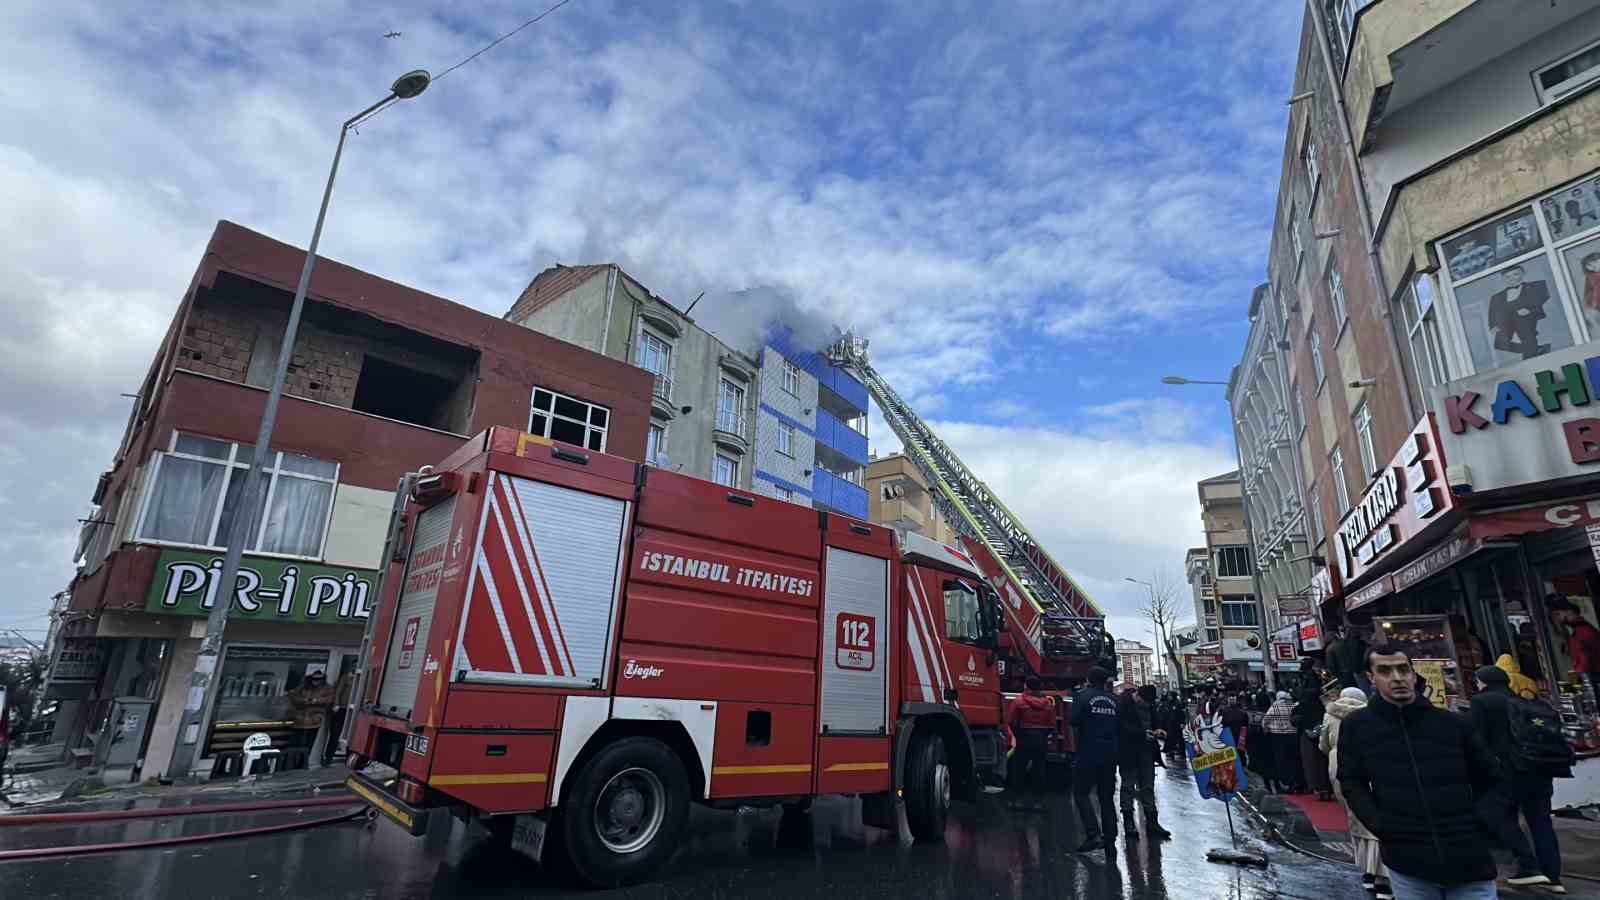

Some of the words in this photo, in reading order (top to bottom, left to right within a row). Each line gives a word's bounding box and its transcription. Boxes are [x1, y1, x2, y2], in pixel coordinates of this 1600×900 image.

[1364, 466, 1398, 531] KASAP
[640, 551, 730, 583] İSTANBUL
[736, 567, 813, 597] İTFAİYESİ
[842, 619, 870, 647] 112
[624, 660, 664, 679] Ziegler
